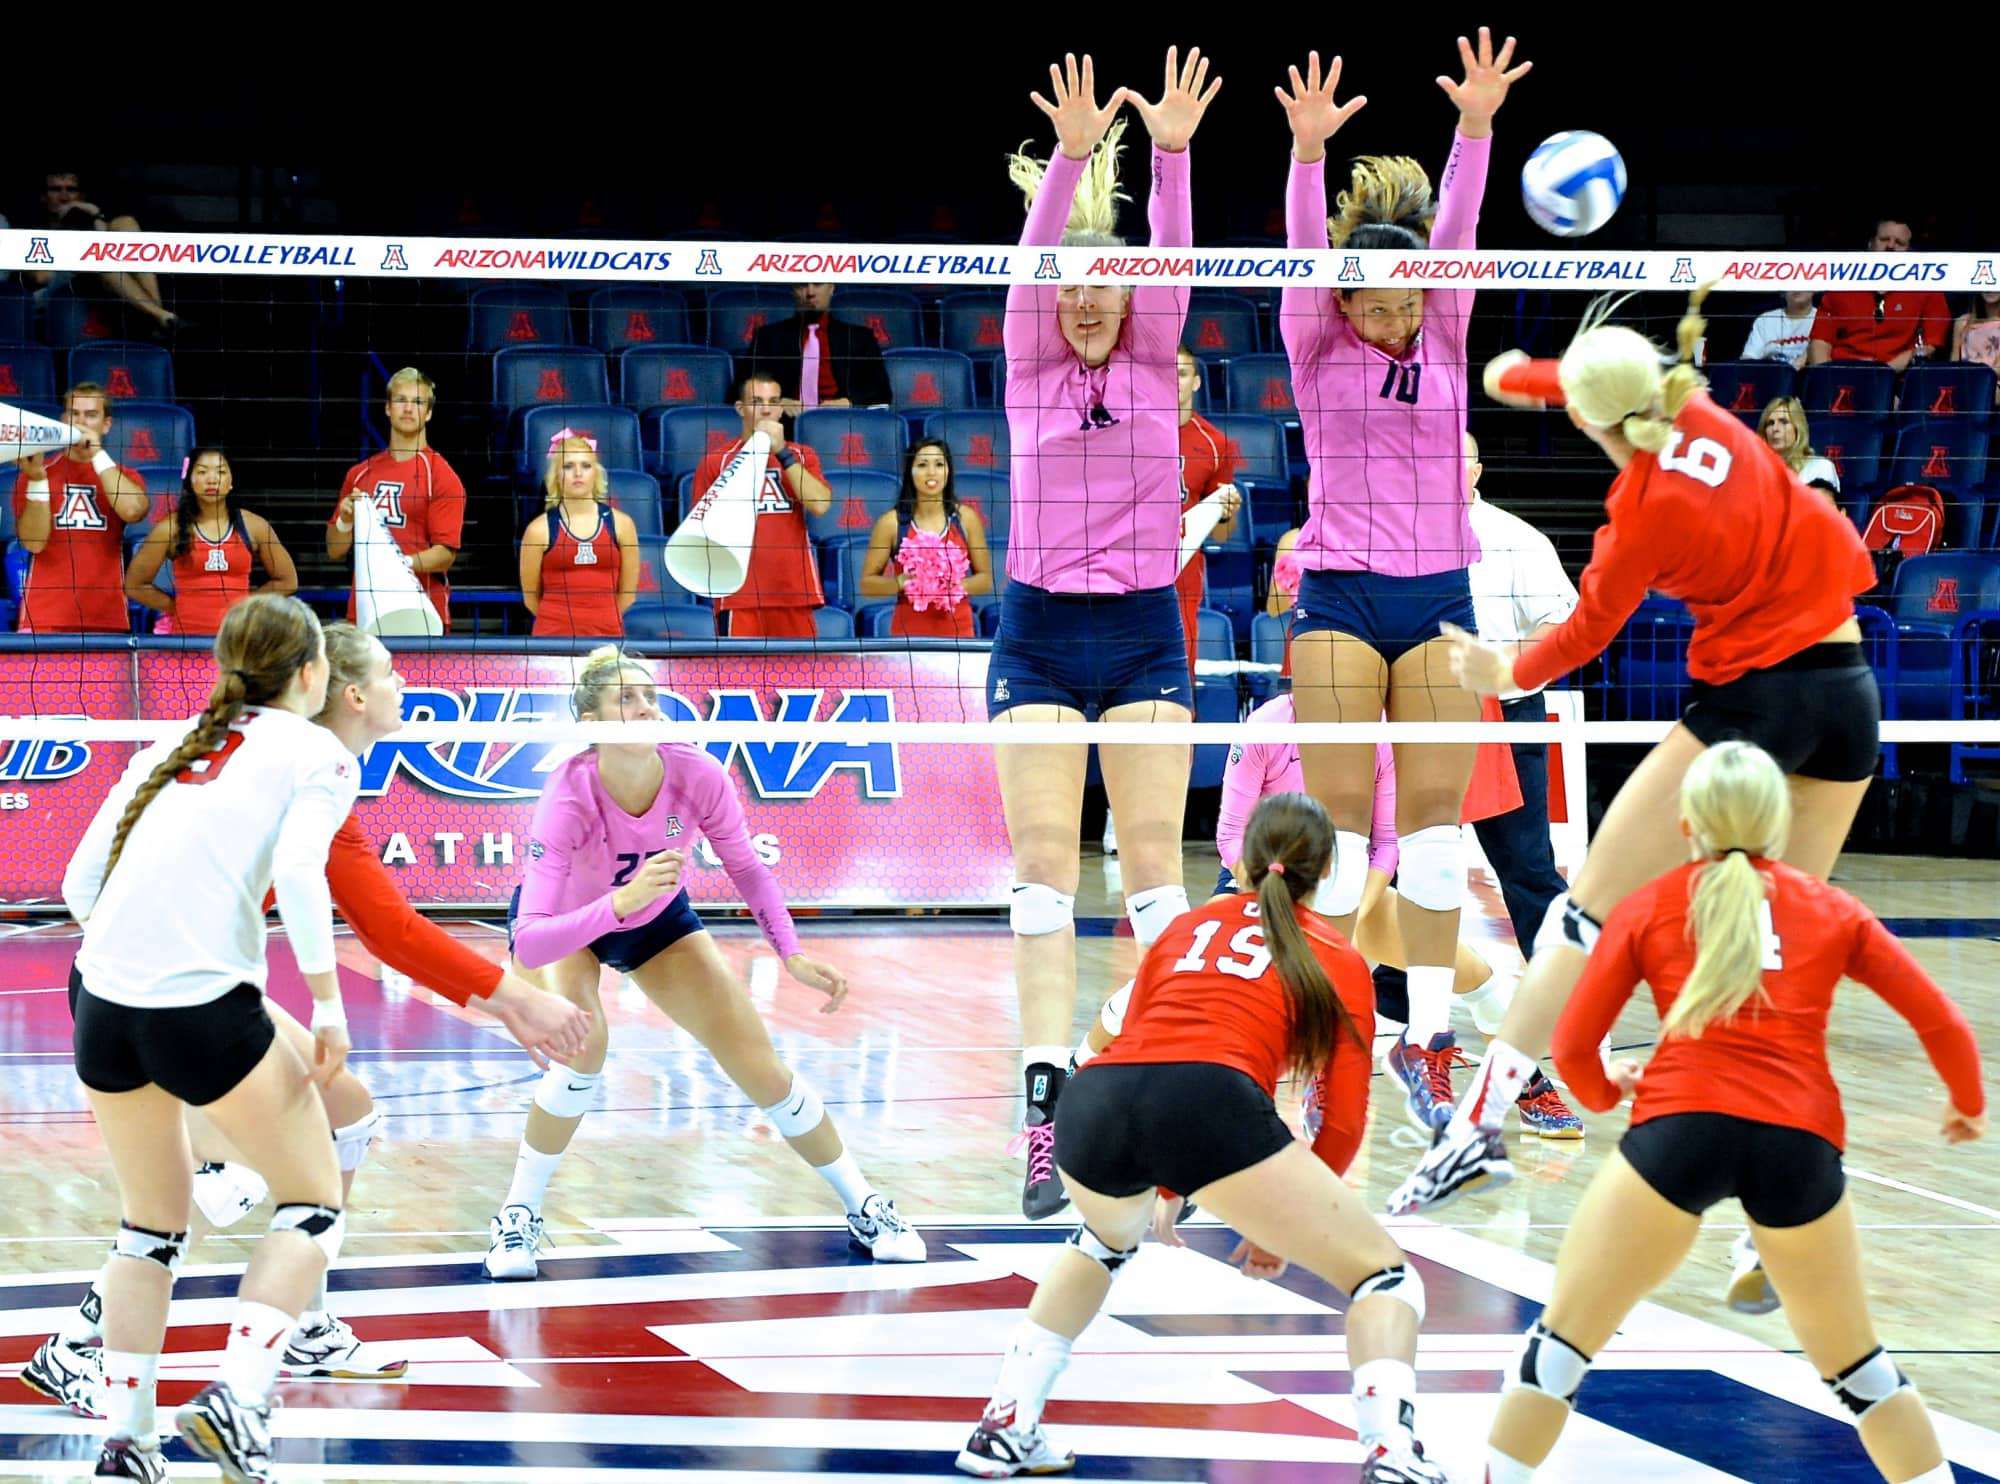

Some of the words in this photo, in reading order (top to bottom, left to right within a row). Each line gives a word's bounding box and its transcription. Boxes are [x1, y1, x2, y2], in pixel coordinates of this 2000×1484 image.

[25, 237, 54, 264] A
[381, 244, 409, 271] A
[696, 248, 722, 275] A
[1035, 253, 1061, 280] A
[1338, 256, 1364, 282] A
[1671, 258, 1696, 284] A
[1971, 260, 1997, 286] A
[1379, 360, 1422, 405] 10
[1658, 432, 1733, 488] 6
[54, 484, 107, 531] A
[373, 480, 407, 529] A
[204, 549, 229, 571] A
[574, 543, 597, 565] A
[1927, 578, 1959, 612] A
[665, 816, 685, 838] A
